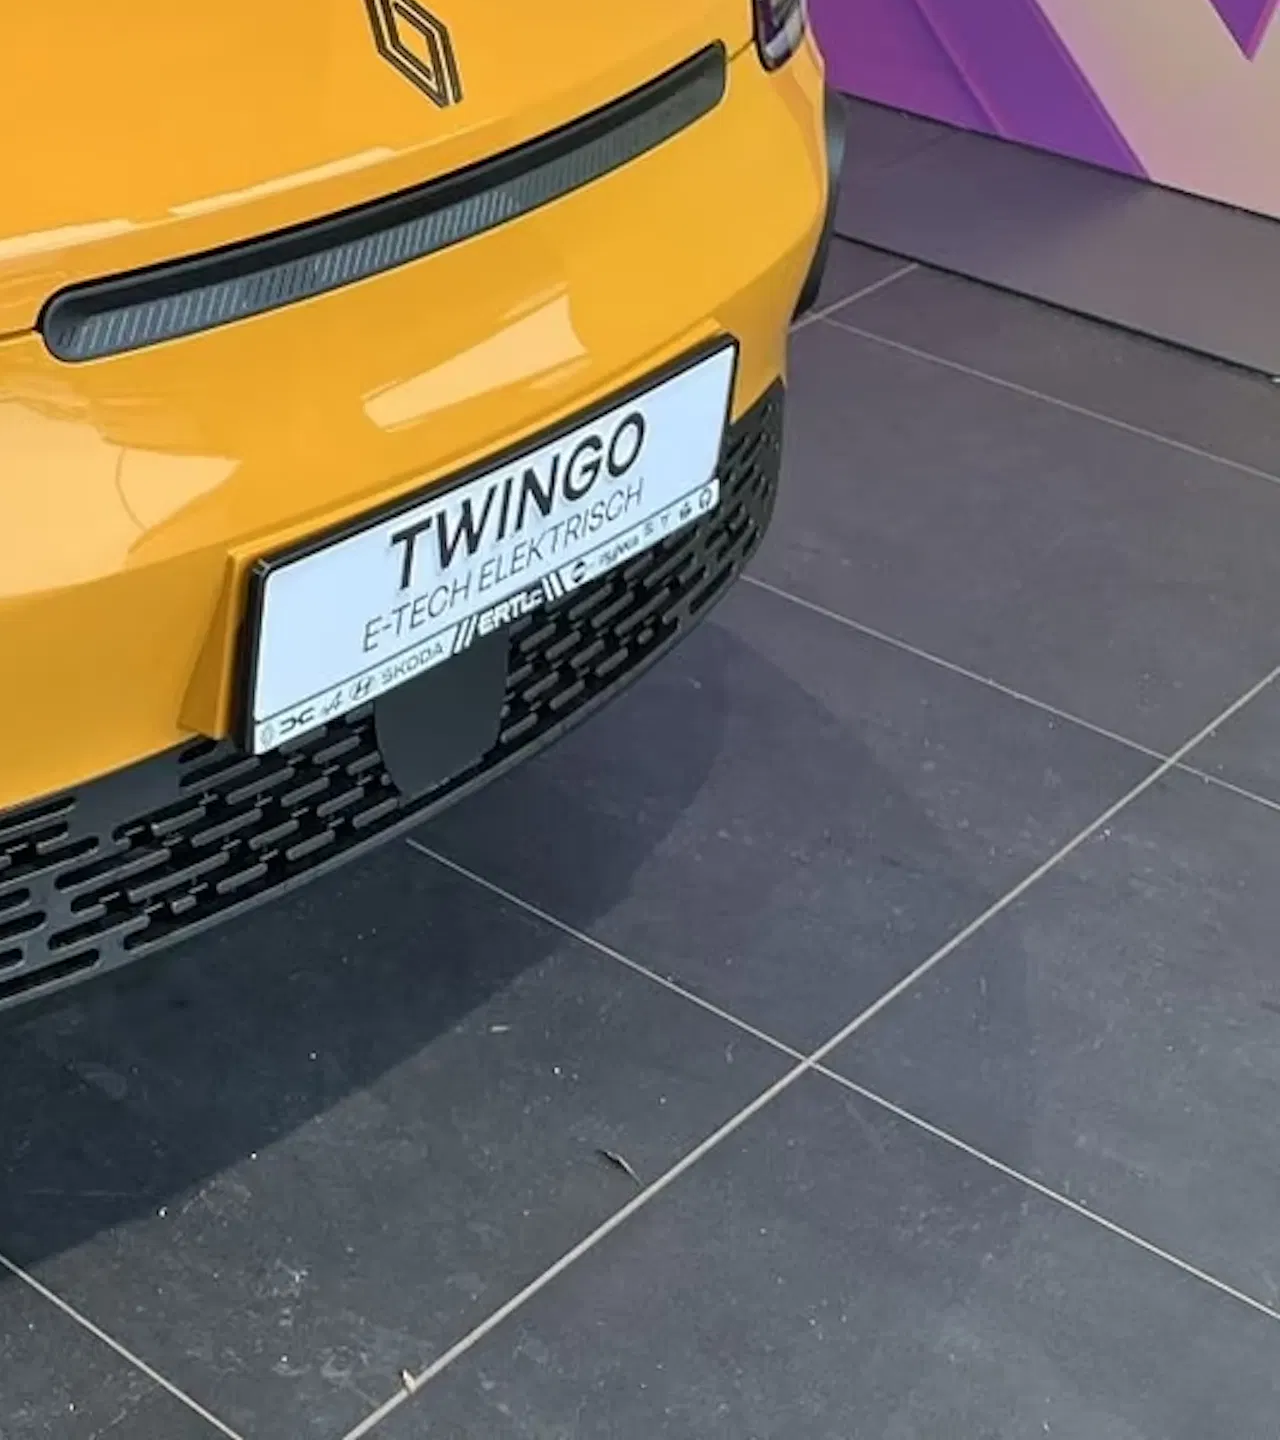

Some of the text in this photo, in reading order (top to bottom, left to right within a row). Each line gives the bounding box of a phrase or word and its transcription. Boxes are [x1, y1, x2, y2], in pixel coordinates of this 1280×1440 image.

[362, 476, 644, 652] E-TECH ELEKTRISCH
[390, 411, 645, 591] TWINGO
